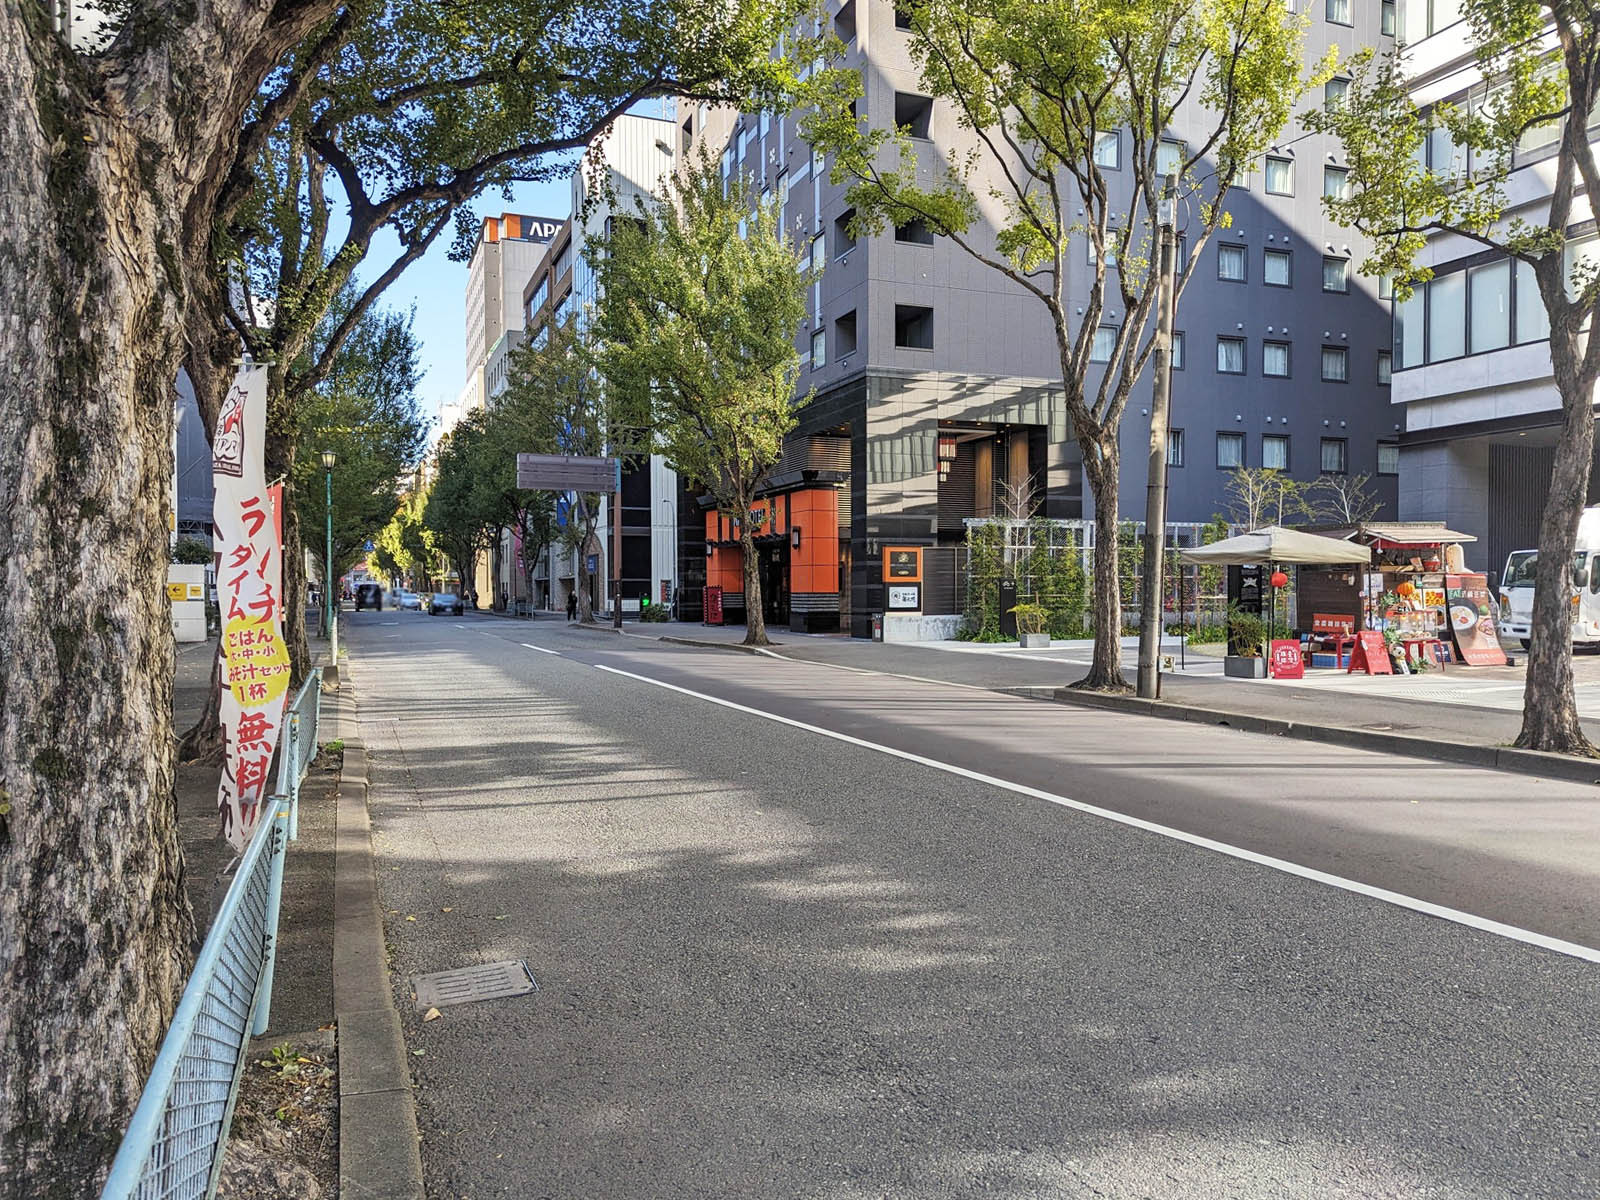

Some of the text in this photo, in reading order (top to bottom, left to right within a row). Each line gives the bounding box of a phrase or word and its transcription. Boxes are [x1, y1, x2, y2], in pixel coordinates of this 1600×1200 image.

[228, 628, 274, 648] ごはん
[236, 711, 274, 801] 無料
